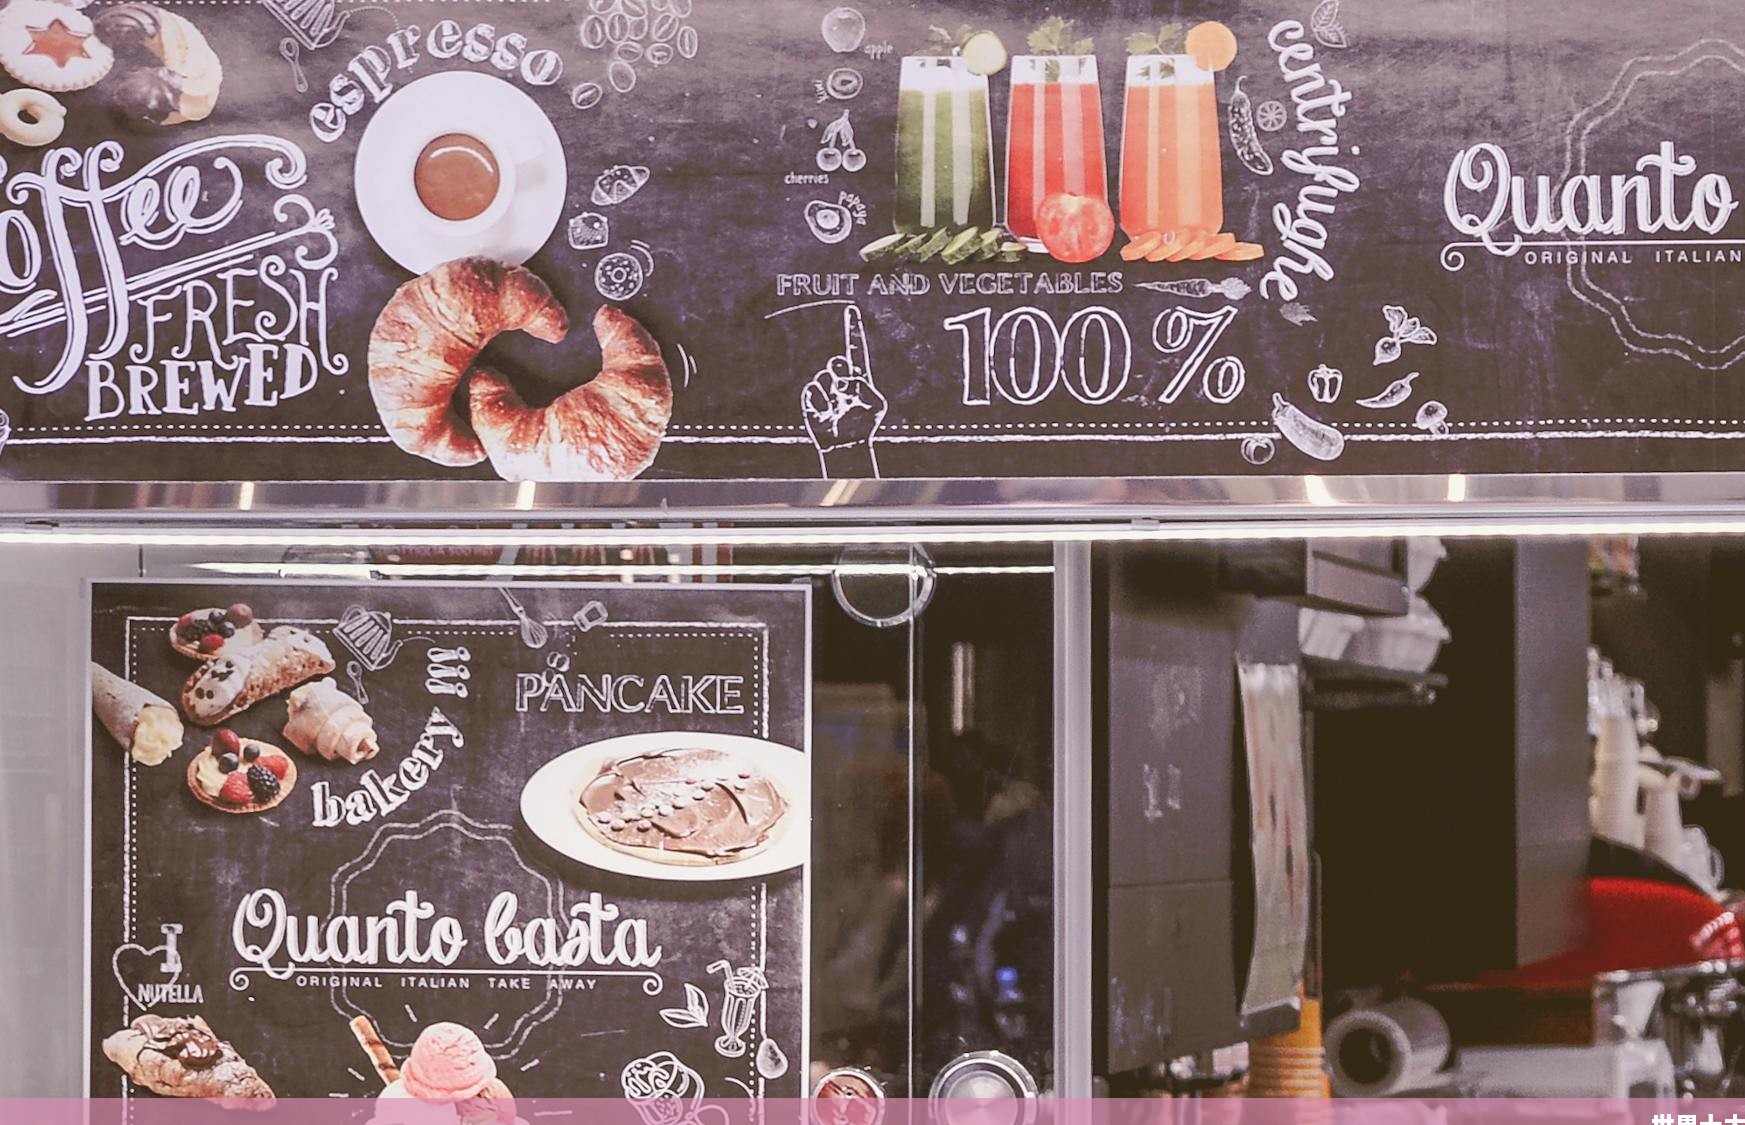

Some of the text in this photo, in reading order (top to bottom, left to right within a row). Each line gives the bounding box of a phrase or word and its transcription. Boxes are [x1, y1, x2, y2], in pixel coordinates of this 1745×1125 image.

[309, 19, 563, 142] espresso
[864, 42, 894, 59] apple
[784, 171, 830, 185] cherries
[1259, 19, 1361, 302] centrifughe
[1443, 140, 1739, 257] Quanto
[838, 190, 868, 226] papaya
[0, 133, 308, 396] offee
[776, 270, 1124, 297] FRUIT AND VEGETABLES
[1525, 250, 1633, 266] ORIGINAL
[1655, 249, 1742, 264] ITALIAN
[129, 255, 350, 378] FRESH
[943, 305, 1246, 406] 100 %
[84, 343, 319, 422] BREWED
[515, 672, 746, 715] PANCAKE
[311, 706, 465, 827] bakery
[230, 888, 663, 980] Quanto basta
[138, 983, 204, 1004] NUTELLA
[296, 975, 598, 991] ORIGINAL ITALIAN TAKE AWAY
